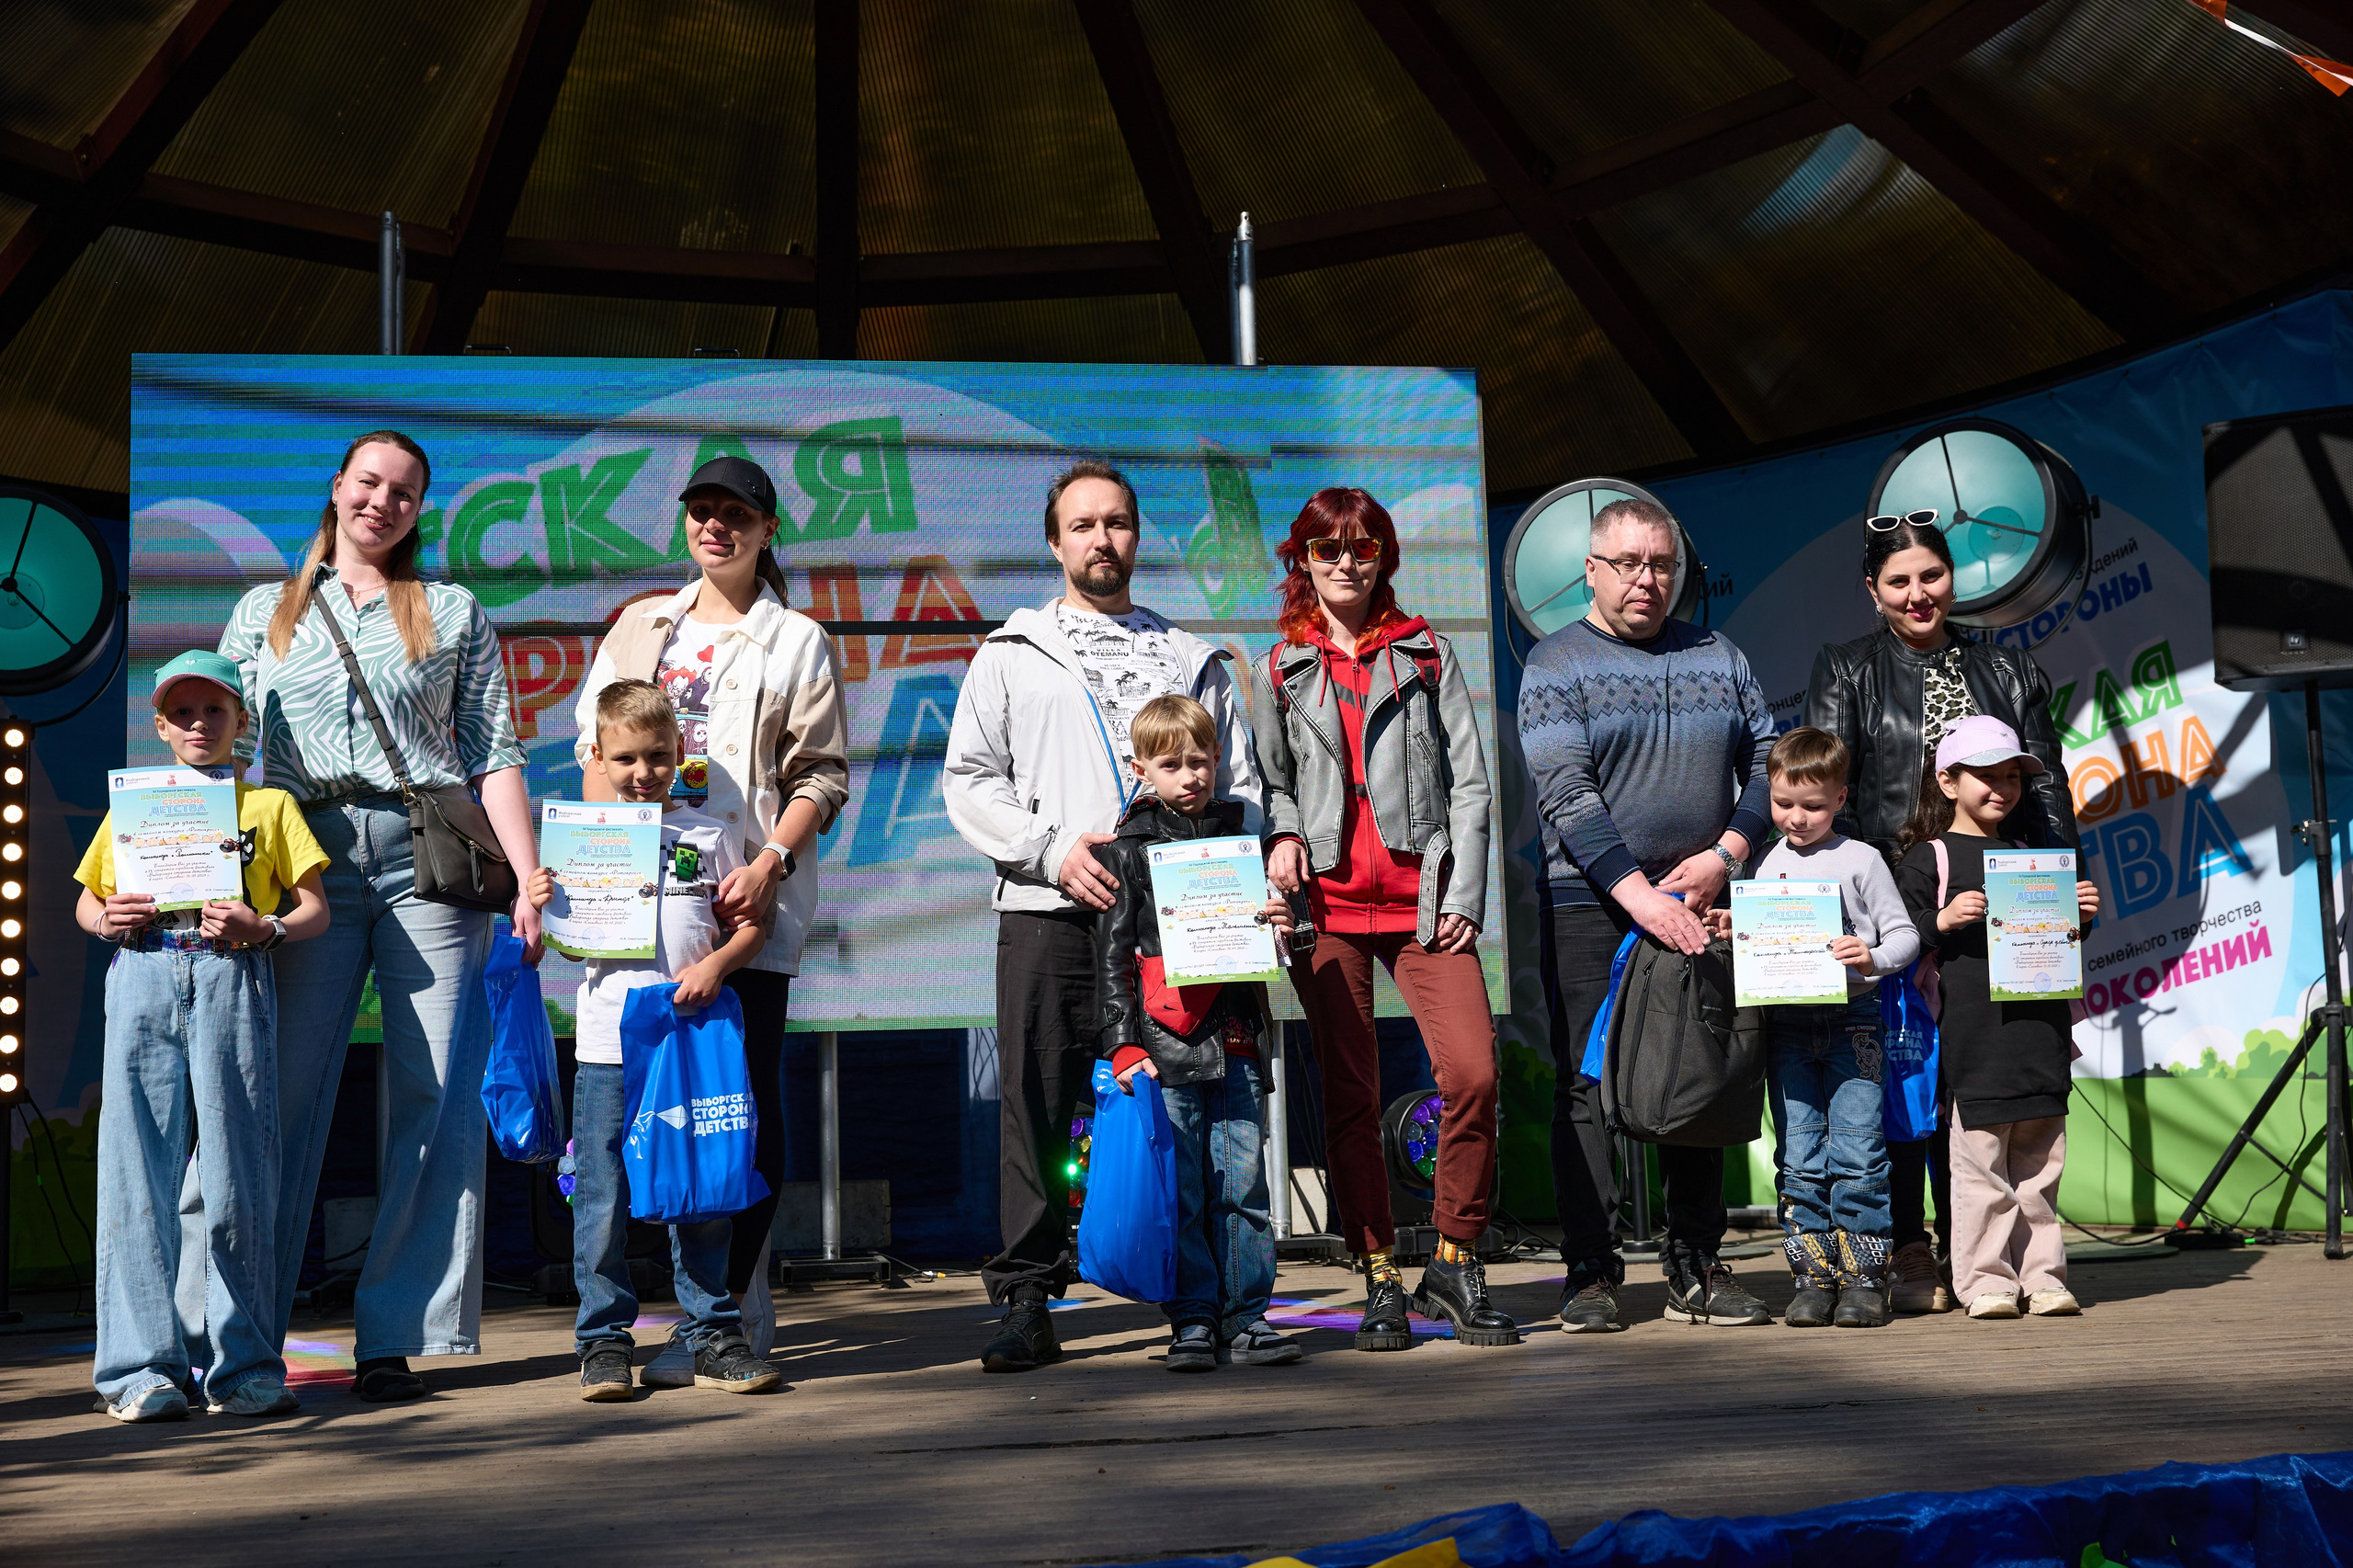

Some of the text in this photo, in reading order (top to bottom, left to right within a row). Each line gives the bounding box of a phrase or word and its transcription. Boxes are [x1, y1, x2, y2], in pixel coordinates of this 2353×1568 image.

[416, 417, 918, 607] СКАЯ
[140, 791, 202, 801] ВЫБОРГСКАЯ
[149, 804, 206, 816] ДЕТСТВА
[576, 845, 631, 855] ДЕТСТВА
[566, 858, 595, 867] Диплом
[1178, 863, 1234, 875] ВЫБОРГСКАЯ
[1198, 870, 1238, 879] СТОРОНА
[1188, 875, 1239, 890] ДЕТСТВА
[2016, 891, 2058, 903] ДЕТСТВА
[1765, 911, 1814, 920] ДЕТСТВА
[2088, 900, 2263, 972] семейного творчества
[2081, 919, 2273, 1015] ОКОЛЕНИЙ
[1885, 1038, 1923, 1050] РОНА
[1887, 1049, 1924, 1062] СТВА
